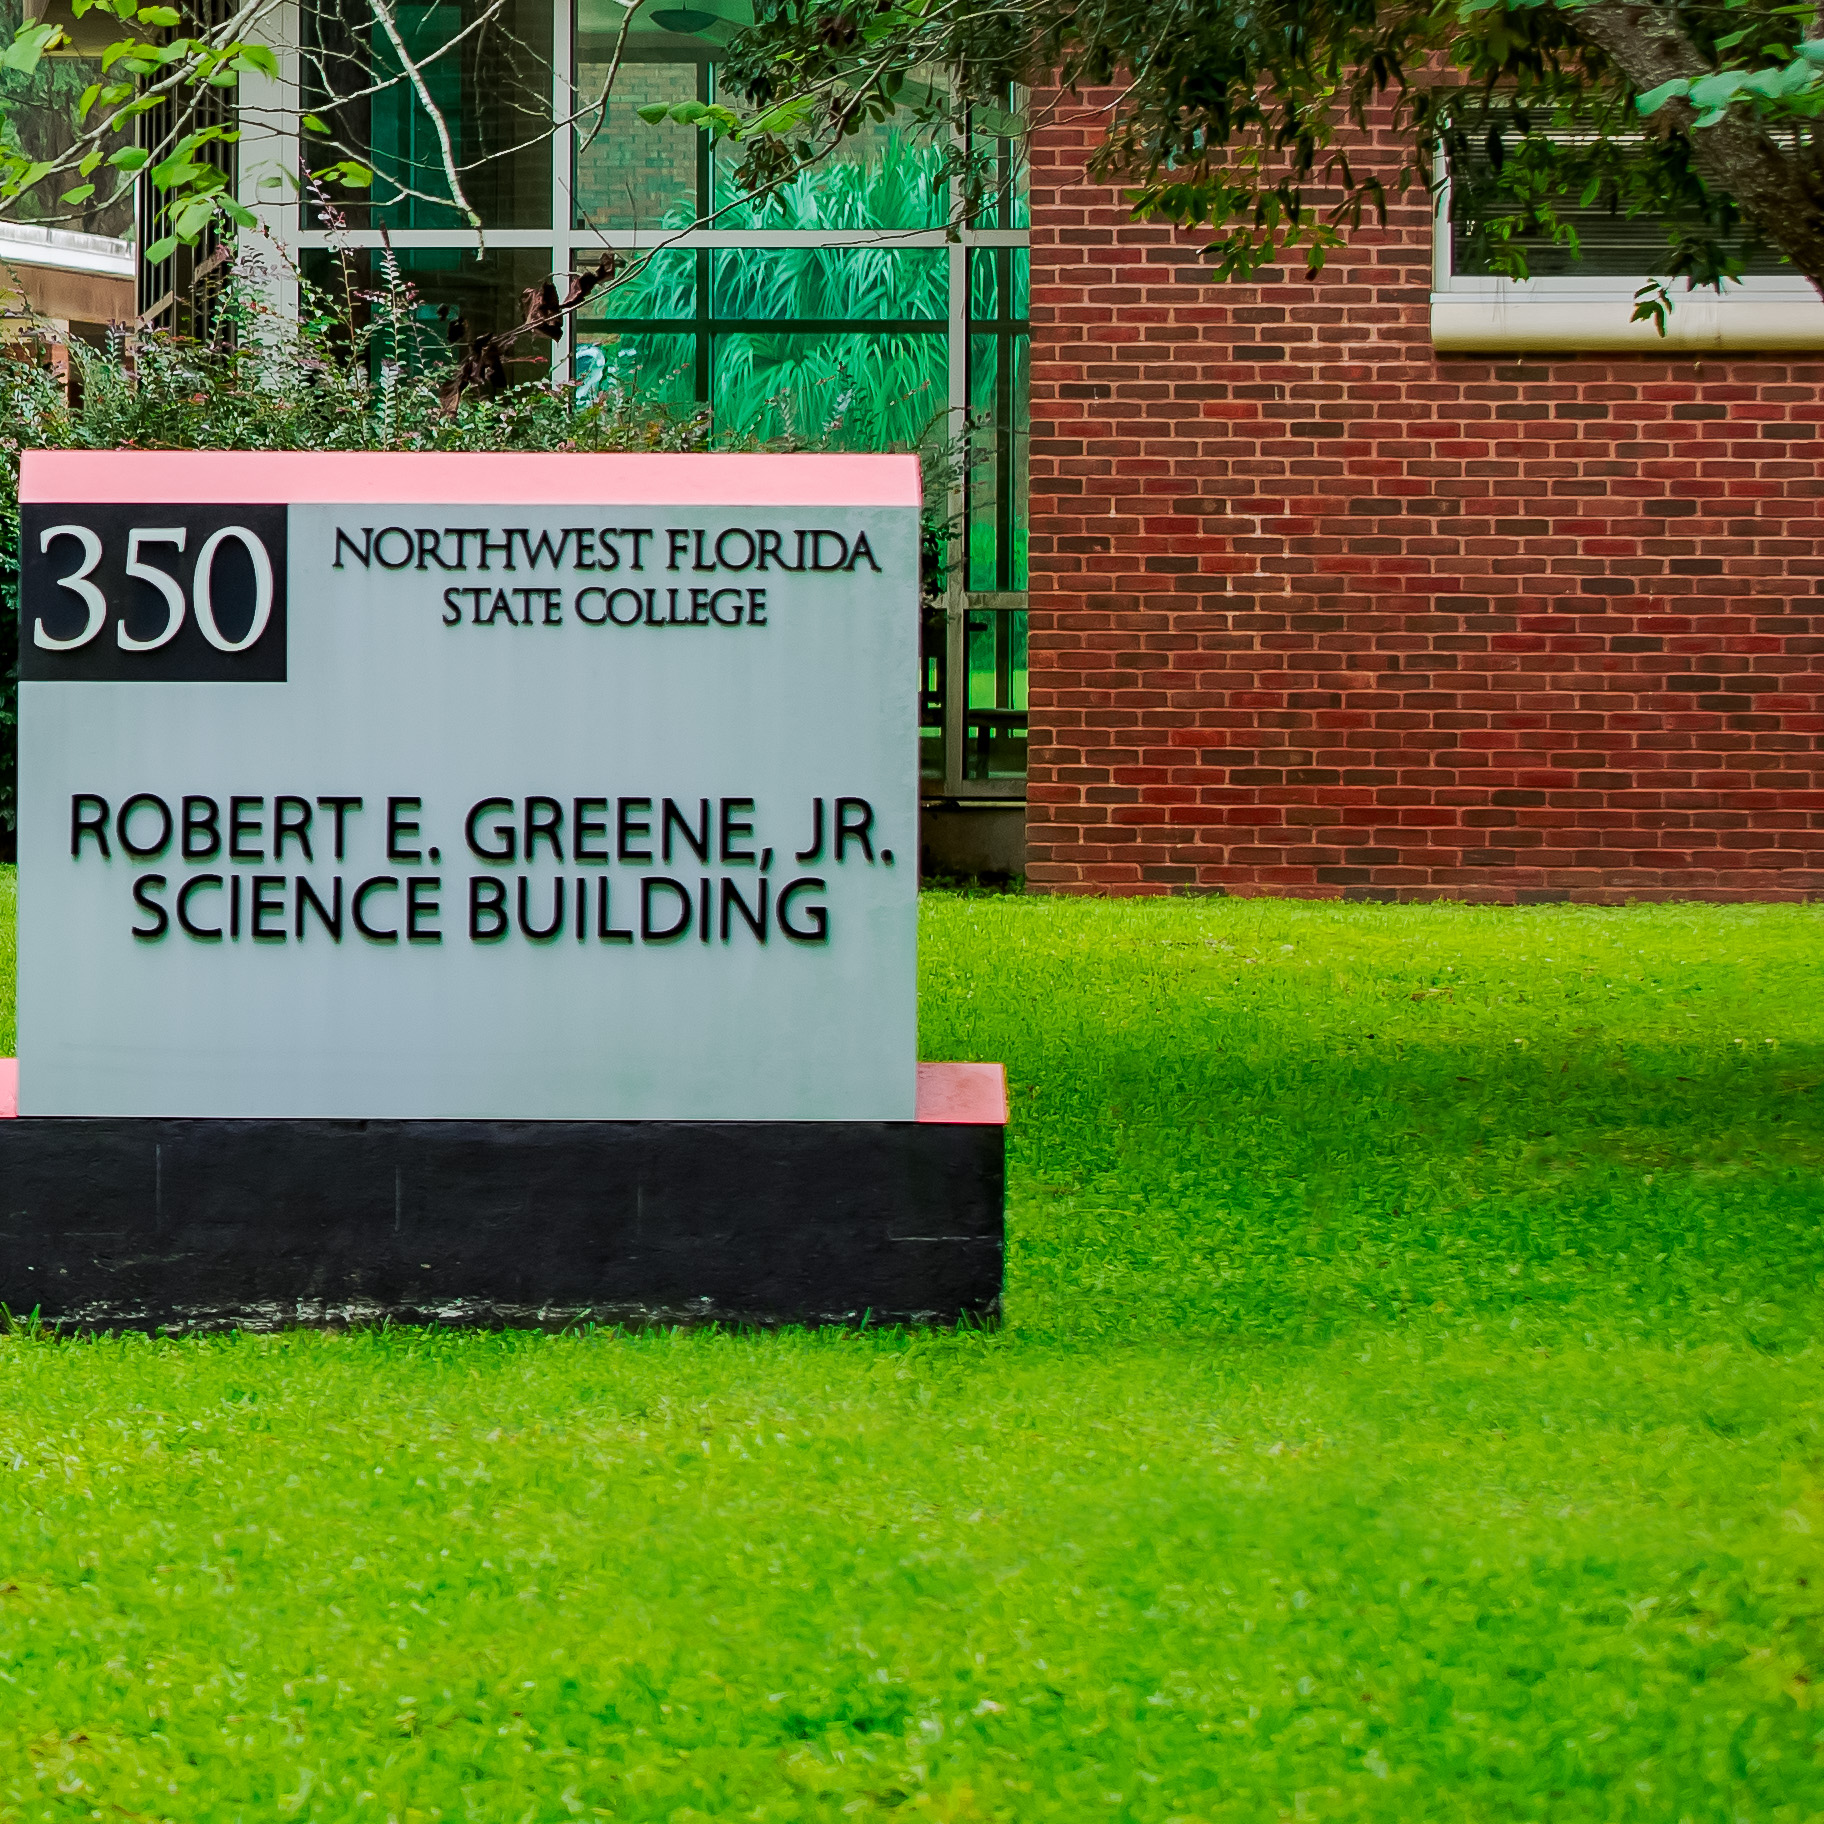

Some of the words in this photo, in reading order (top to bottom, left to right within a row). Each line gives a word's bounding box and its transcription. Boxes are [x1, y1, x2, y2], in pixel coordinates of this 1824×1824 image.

[332, 526, 654, 573] NORTHWEST
[664, 527, 884, 574] FLORIDA
[32, 523, 276, 654] 350
[441, 586, 564, 628] STATE
[574, 586, 769, 628] COLLEGE
[69, 792, 364, 864] ROBERT
[385, 795, 441, 865] E.
[463, 795, 775, 875] GREENE,
[794, 795, 896, 867] JR.
[130, 872, 443, 946] SCIENCE
[468, 874, 830, 948] BUILDING
